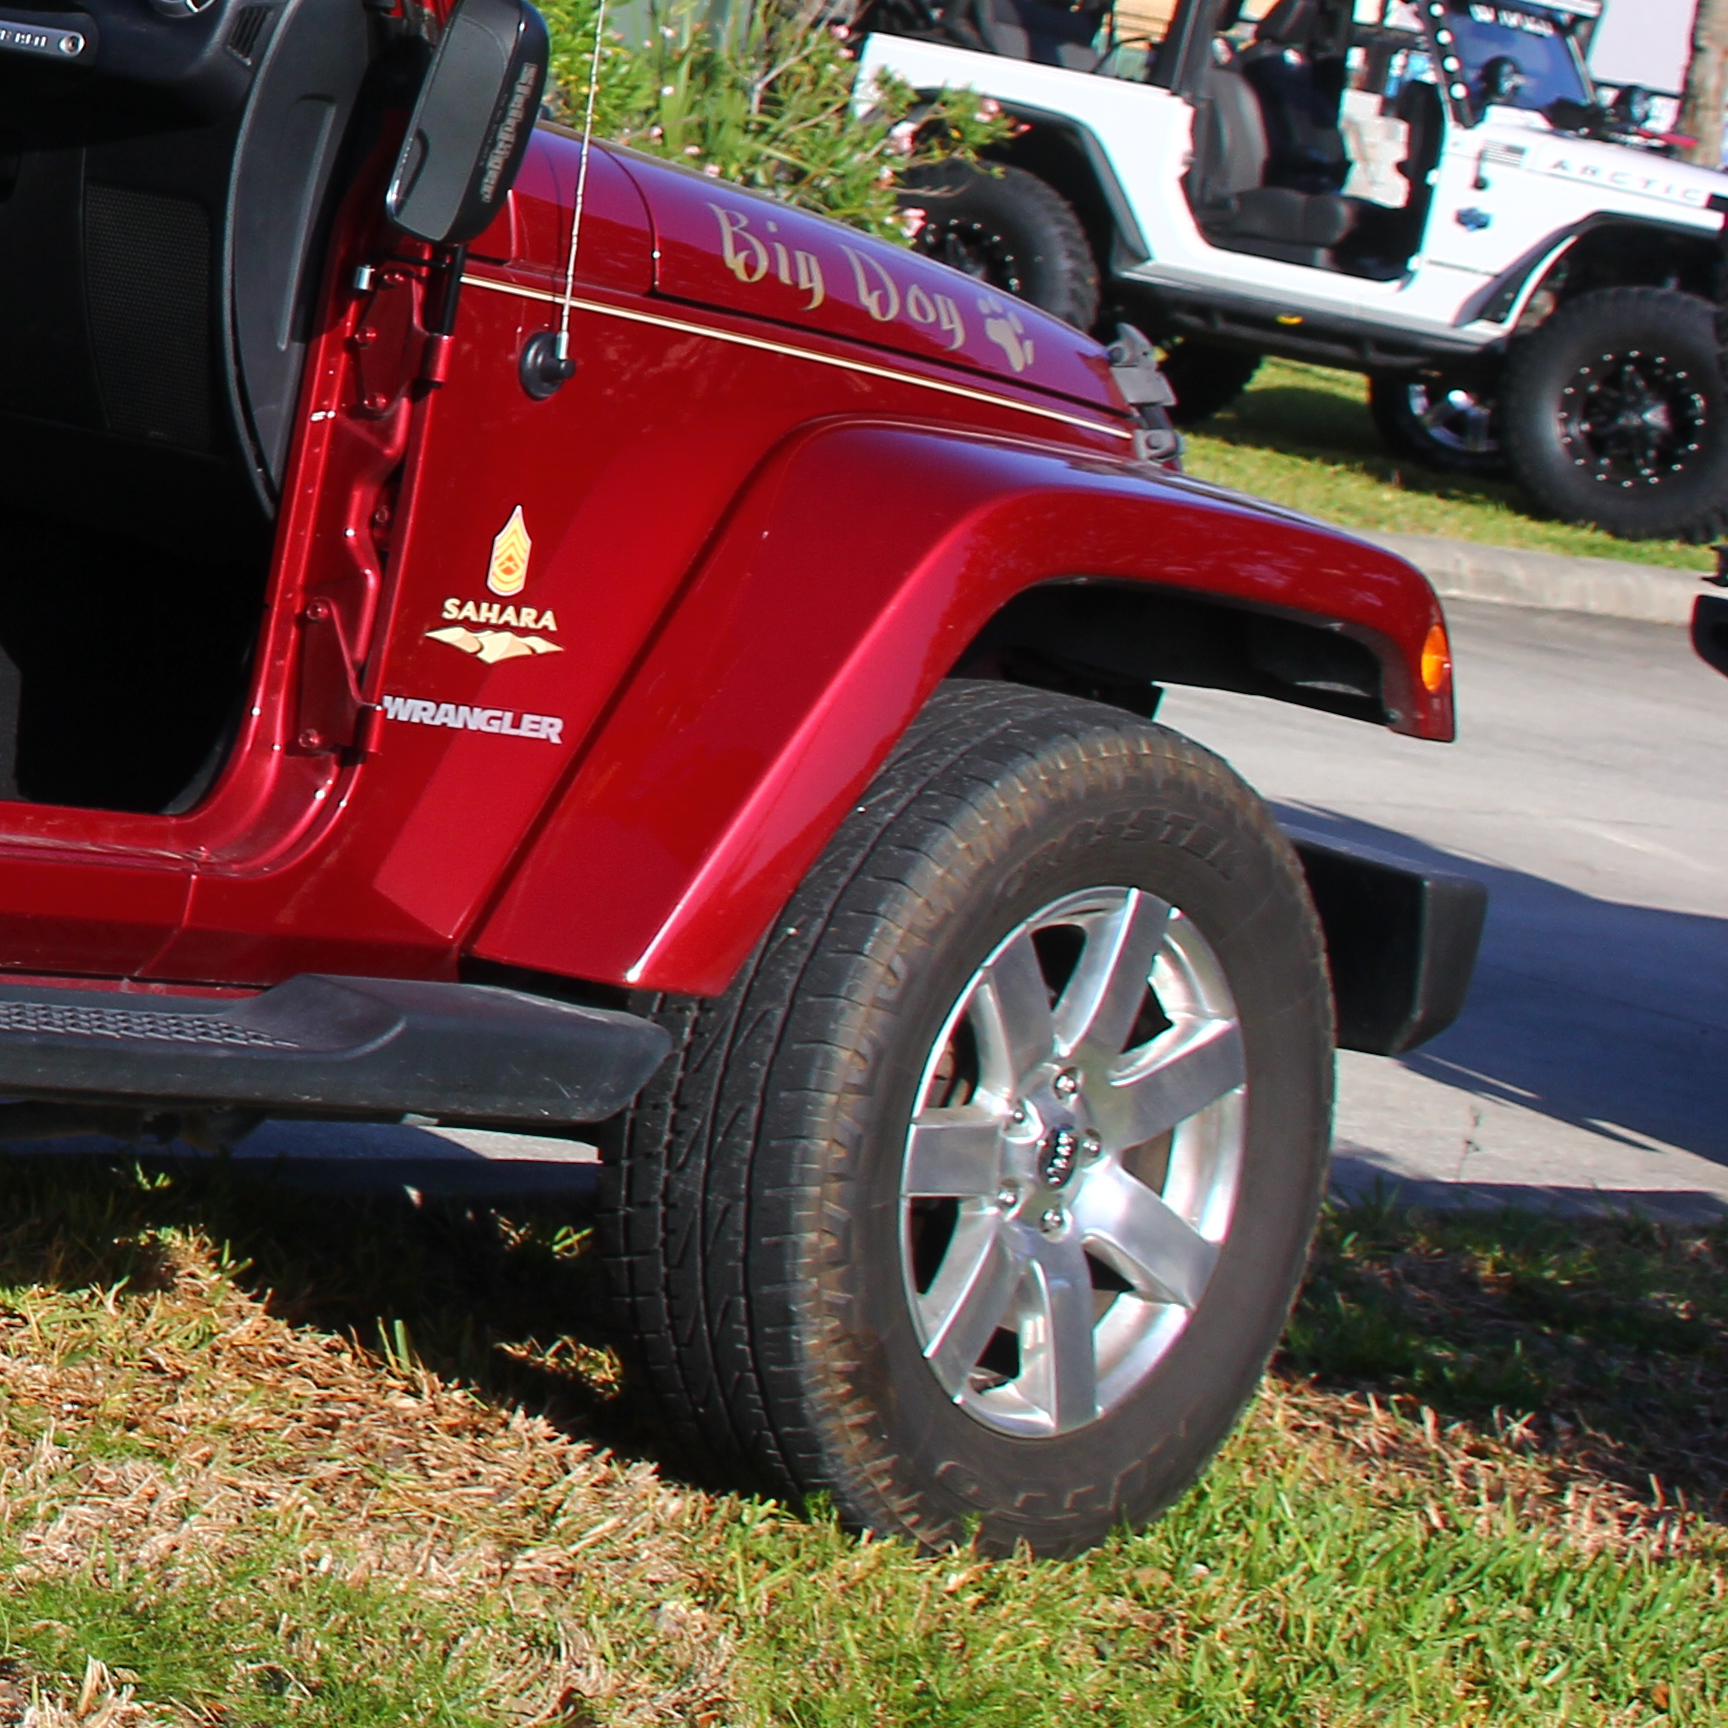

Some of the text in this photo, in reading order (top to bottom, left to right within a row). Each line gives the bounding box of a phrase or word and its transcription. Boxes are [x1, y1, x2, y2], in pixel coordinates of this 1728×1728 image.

[1550, 158, 1703, 202] ARCTIC
[706, 201, 966, 352] Big Dog
[441, 597, 558, 631] SAHARA
[381, 693, 564, 745] WRANGLER
